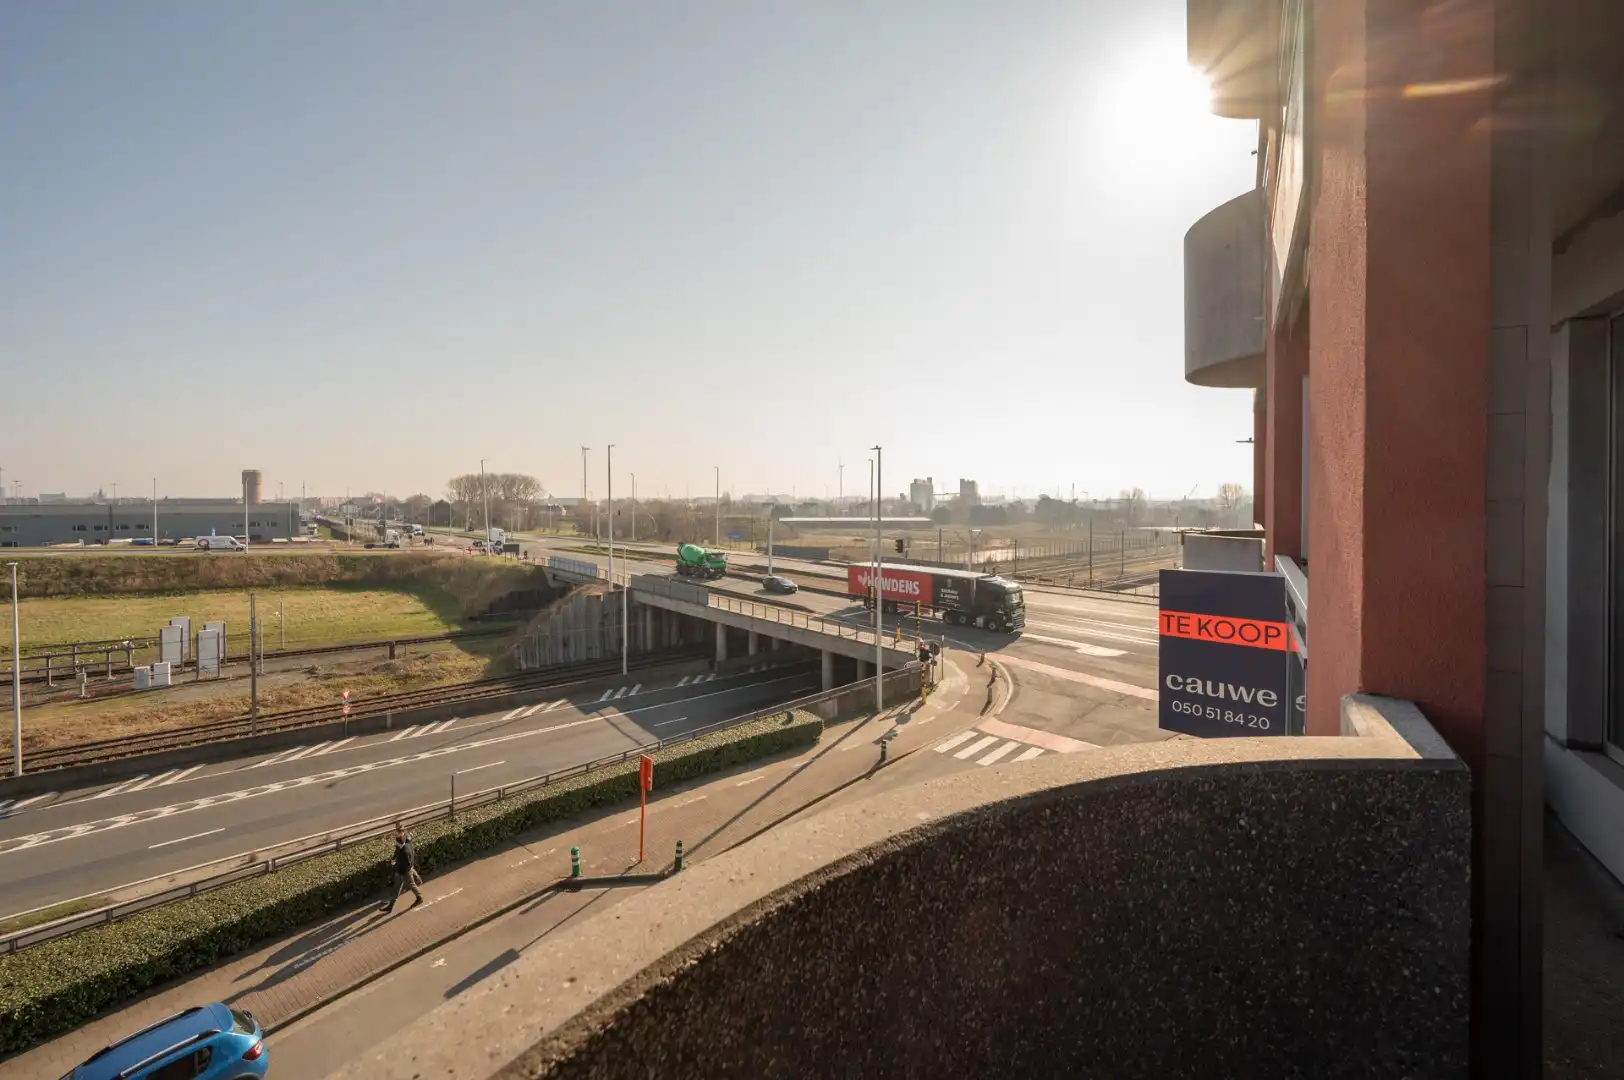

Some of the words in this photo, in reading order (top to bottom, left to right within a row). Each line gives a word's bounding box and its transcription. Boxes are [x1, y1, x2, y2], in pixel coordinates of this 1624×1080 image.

[1161, 614, 1191, 634] TE
[1197, 617, 1281, 644] KOOP
[1166, 674, 1278, 707] cauwe
[1172, 700, 1203, 717] 050
[1205, 707, 1221, 721] 51
[1224, 711, 1245, 726] 84
[1248, 715, 1270, 730] 20
